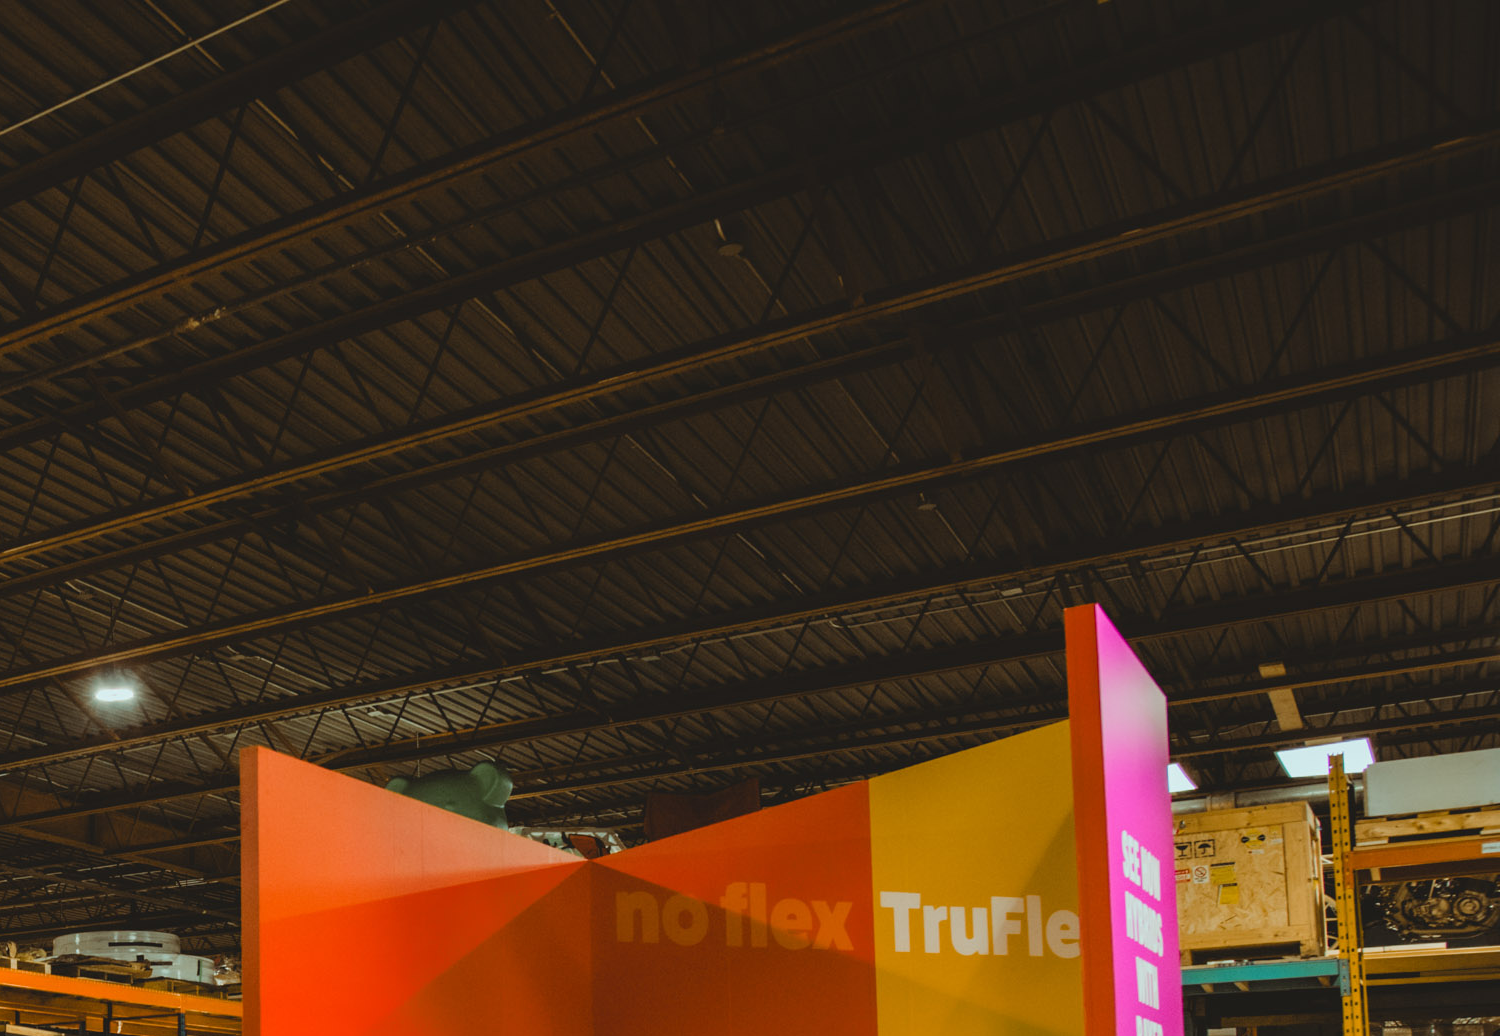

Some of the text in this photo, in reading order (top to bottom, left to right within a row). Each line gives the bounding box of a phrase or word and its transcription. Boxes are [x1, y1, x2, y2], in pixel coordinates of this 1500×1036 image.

[1121, 830, 1141, 886] SEE
[615, 882, 855, 951] no flex
[879, 891, 1081, 958] TruFle
